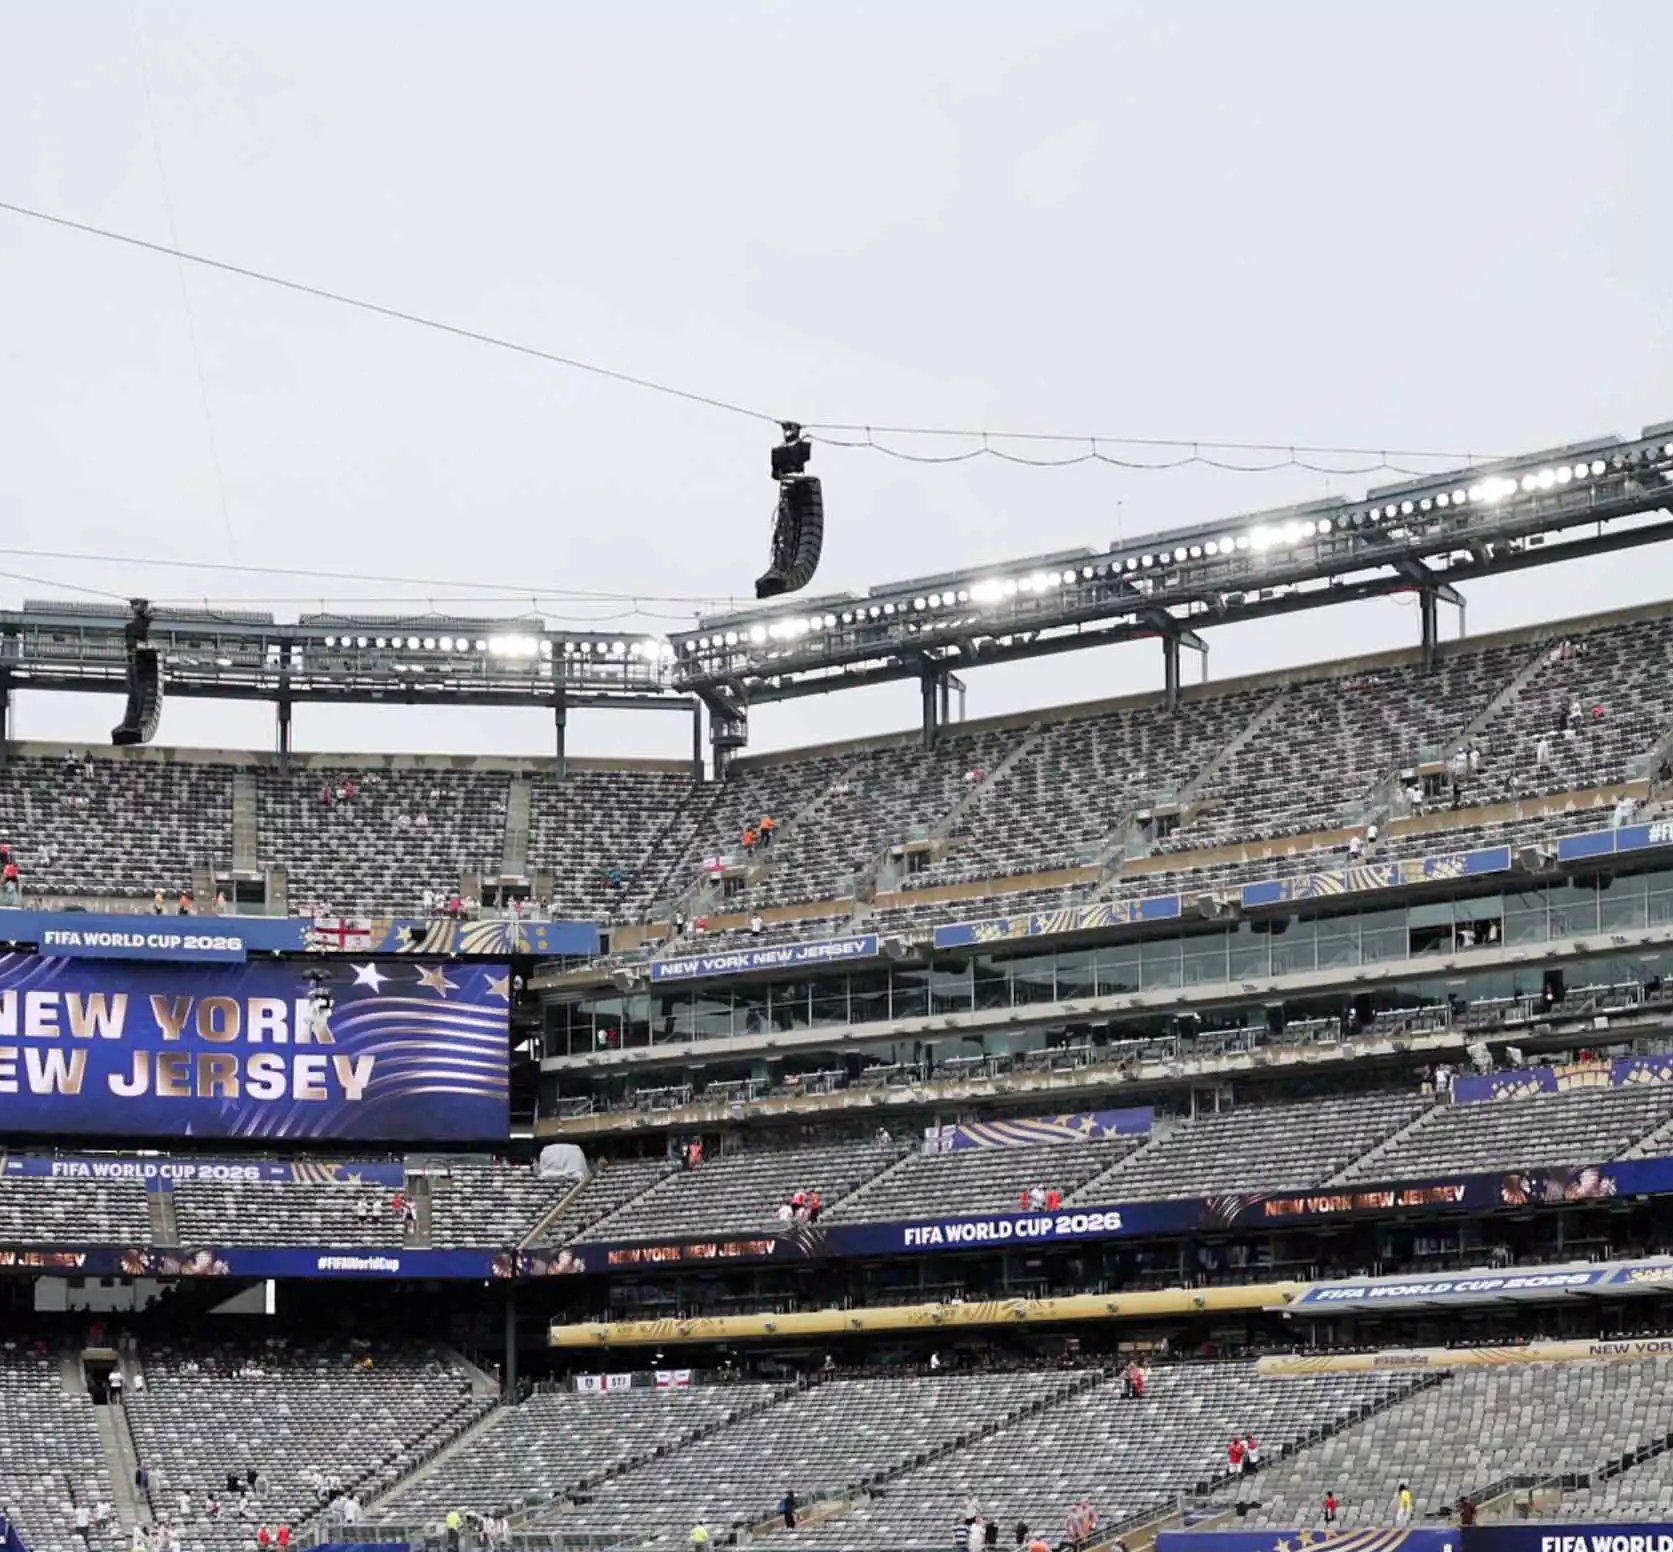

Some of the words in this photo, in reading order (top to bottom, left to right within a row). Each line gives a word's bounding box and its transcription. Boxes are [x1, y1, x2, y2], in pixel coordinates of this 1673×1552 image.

[44, 931, 81, 945] FIFA
[83, 932, 144, 948] WORLD
[148, 935, 181, 949] CUP
[183, 936, 242, 950] 2026
[660, 961, 698, 976] NEW
[702, 957, 748, 971] YORK
[753, 952, 792, 965] NEW
[795, 941, 866, 958] JERSEY
[149, 995, 336, 1045] YORK
[108, 1051, 376, 1101] JERSEY
[52, 1162, 90, 1176] FIFA
[92, 1163, 157, 1178] WORLD
[160, 1165, 196, 1179] CUP
[198, 1166, 260, 1180] 2026
[1308, 1196, 1352, 1213] YORK
[904, 1227, 944, 1245] FIFA
[945, 1221, 1012, 1241] WORLD
[1015, 1218, 1053, 1237] CUP
[1055, 1212, 1122, 1234] 2026
[318, 1256, 400, 1272] #FIFAWorldCup
[1316, 1288, 1365, 1300] FIFA
[1369, 1283, 1451, 1298] WORLD
[1454, 1280, 1504, 1292] CUP
[1502, 1273, 1591, 1289] 2026
[1589, 1343, 1629, 1355] NEW
